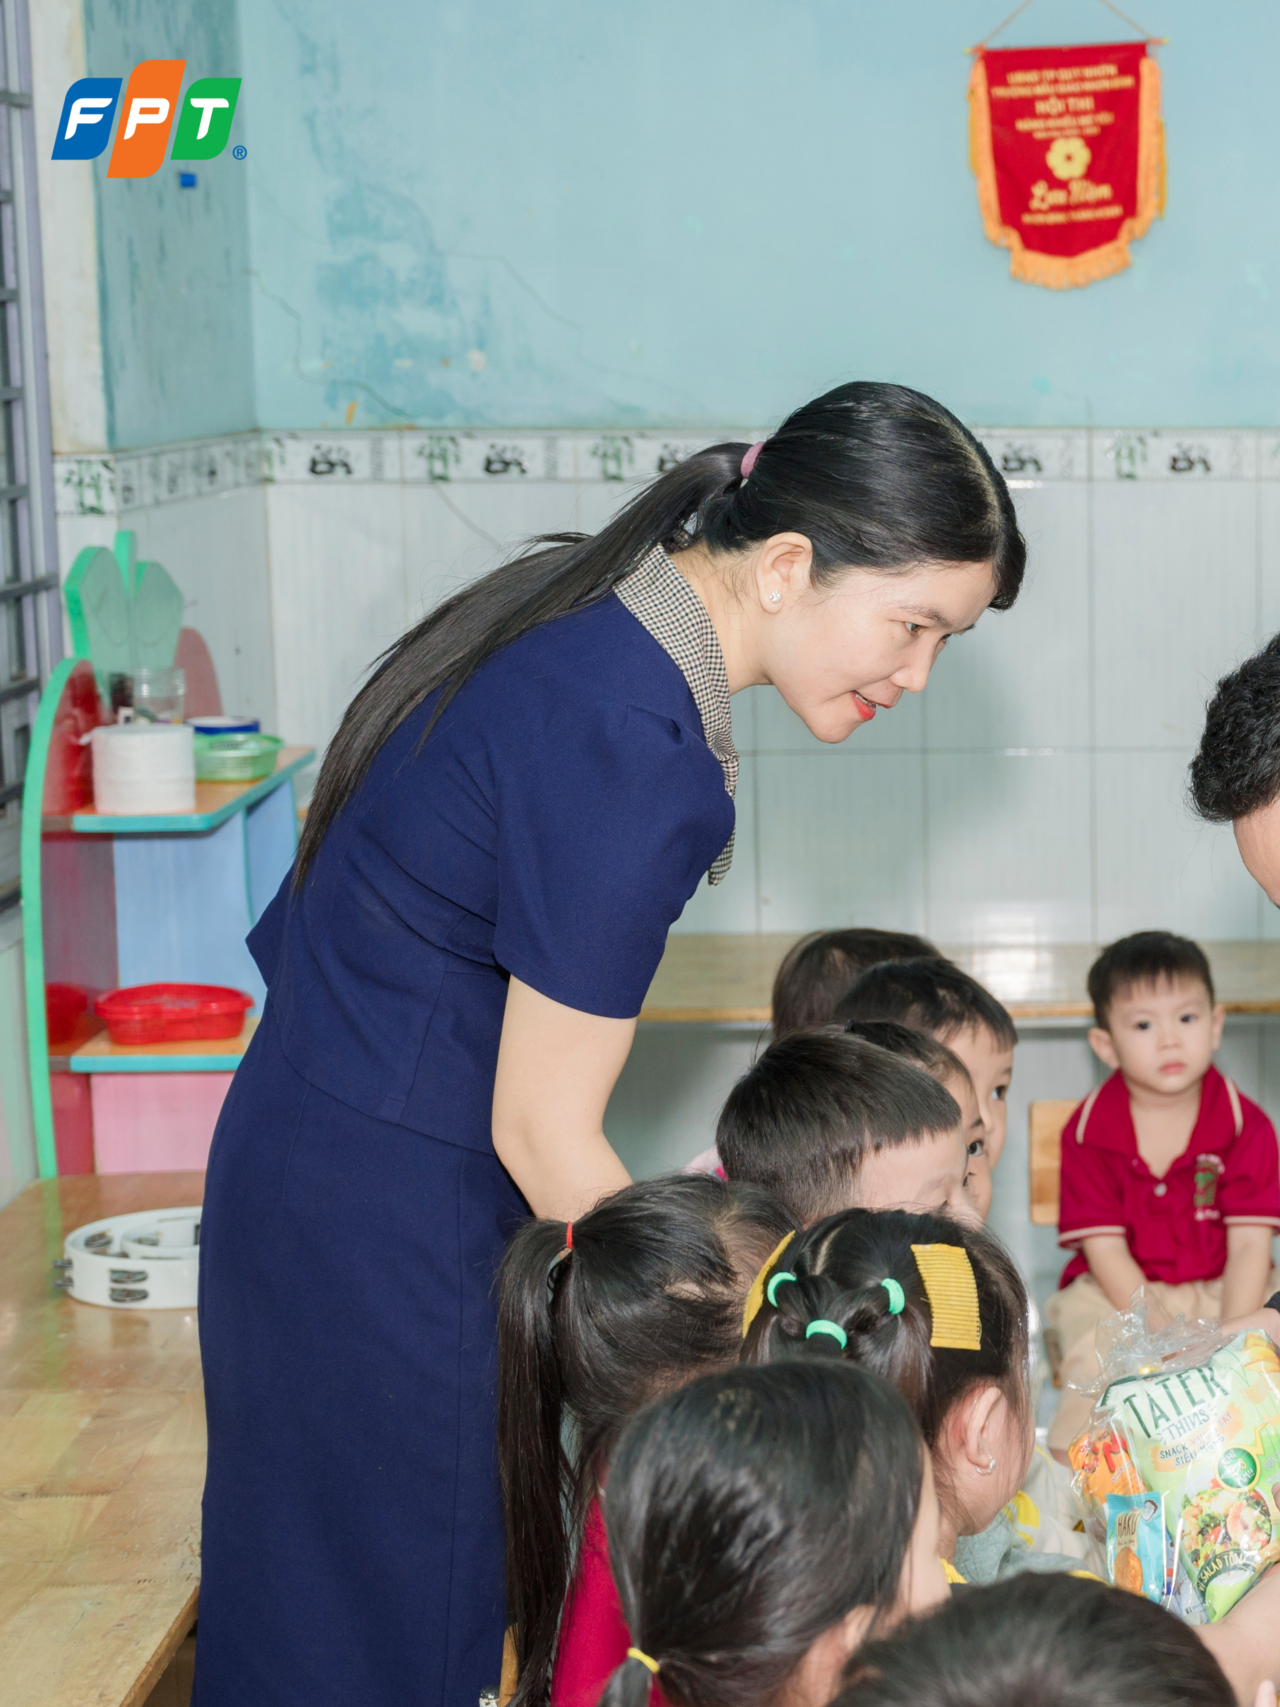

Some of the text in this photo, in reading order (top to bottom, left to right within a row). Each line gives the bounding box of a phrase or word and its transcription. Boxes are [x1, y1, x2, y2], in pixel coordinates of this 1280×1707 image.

[1035, 95, 1094, 116] HỘI THI
[1123, 1366, 1230, 1439] TATER
[1160, 1442, 1189, 1460] SNACK
[1217, 1410, 1233, 1428] TAY
[1162, 1408, 1210, 1441] THINS
[1200, 1557, 1224, 1583] SALAD
